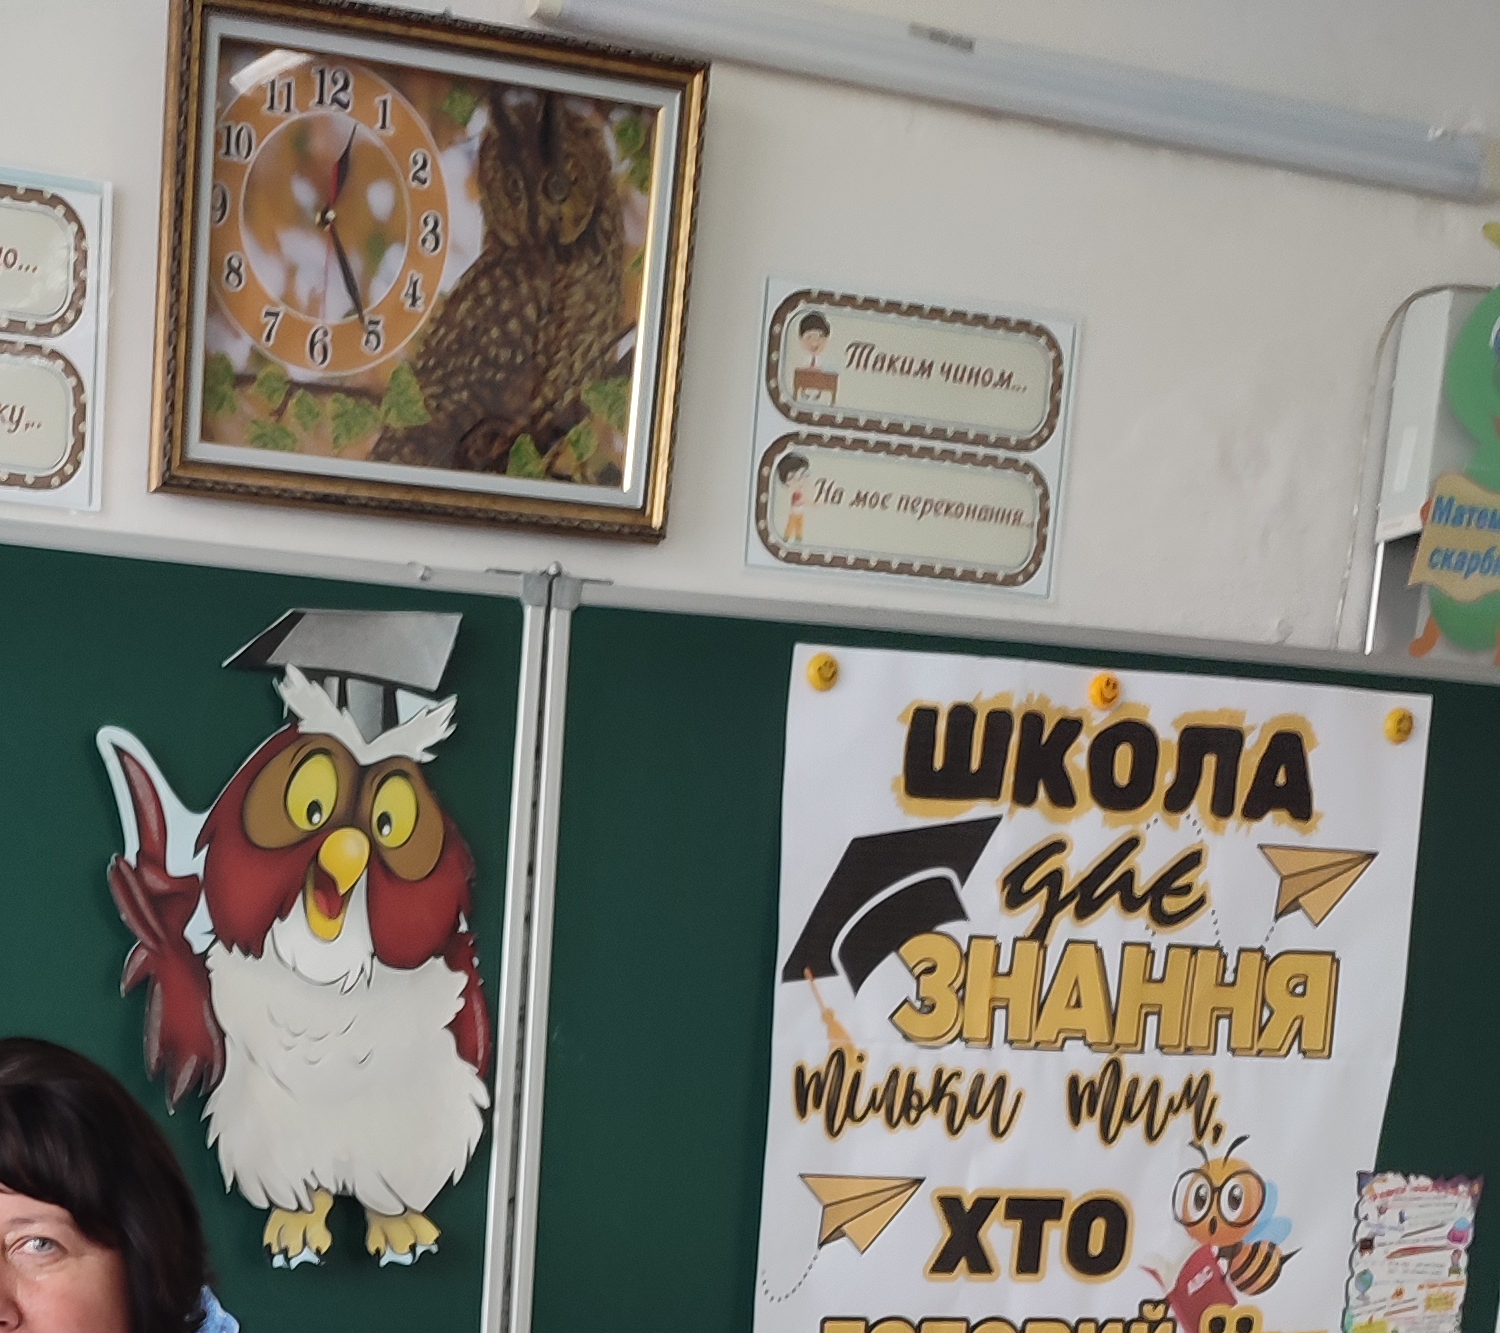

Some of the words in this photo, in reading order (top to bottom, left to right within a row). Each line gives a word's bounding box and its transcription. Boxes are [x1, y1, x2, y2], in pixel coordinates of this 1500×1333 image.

[263, 77, 295, 115] 11
[312, 66, 353, 111] 12
[375, 94, 396, 135] 1
[221, 122, 256, 163] 10
[409, 150, 432, 188] 2
[212, 183, 231, 227] 9
[420, 211, 442, 255] 3
[223, 253, 246, 292] 8
[404, 271, 424, 310] 4
[261, 307, 284, 346] 7
[307, 324, 331, 368] 6
[363, 318, 385, 355] 5
[844, 340, 935, 380] Таким
[813, 477, 845, 506] На
[902, 700, 1314, 824] ШКОЛА
[1000, 834, 1208, 945] дає
[888, 933, 1341, 1059] ЗНАННЯ
[795, 1047, 1024, 1140] тільки
[1066, 1057, 1224, 1146] тим,
[928, 1194, 1129, 1277] ХТО
